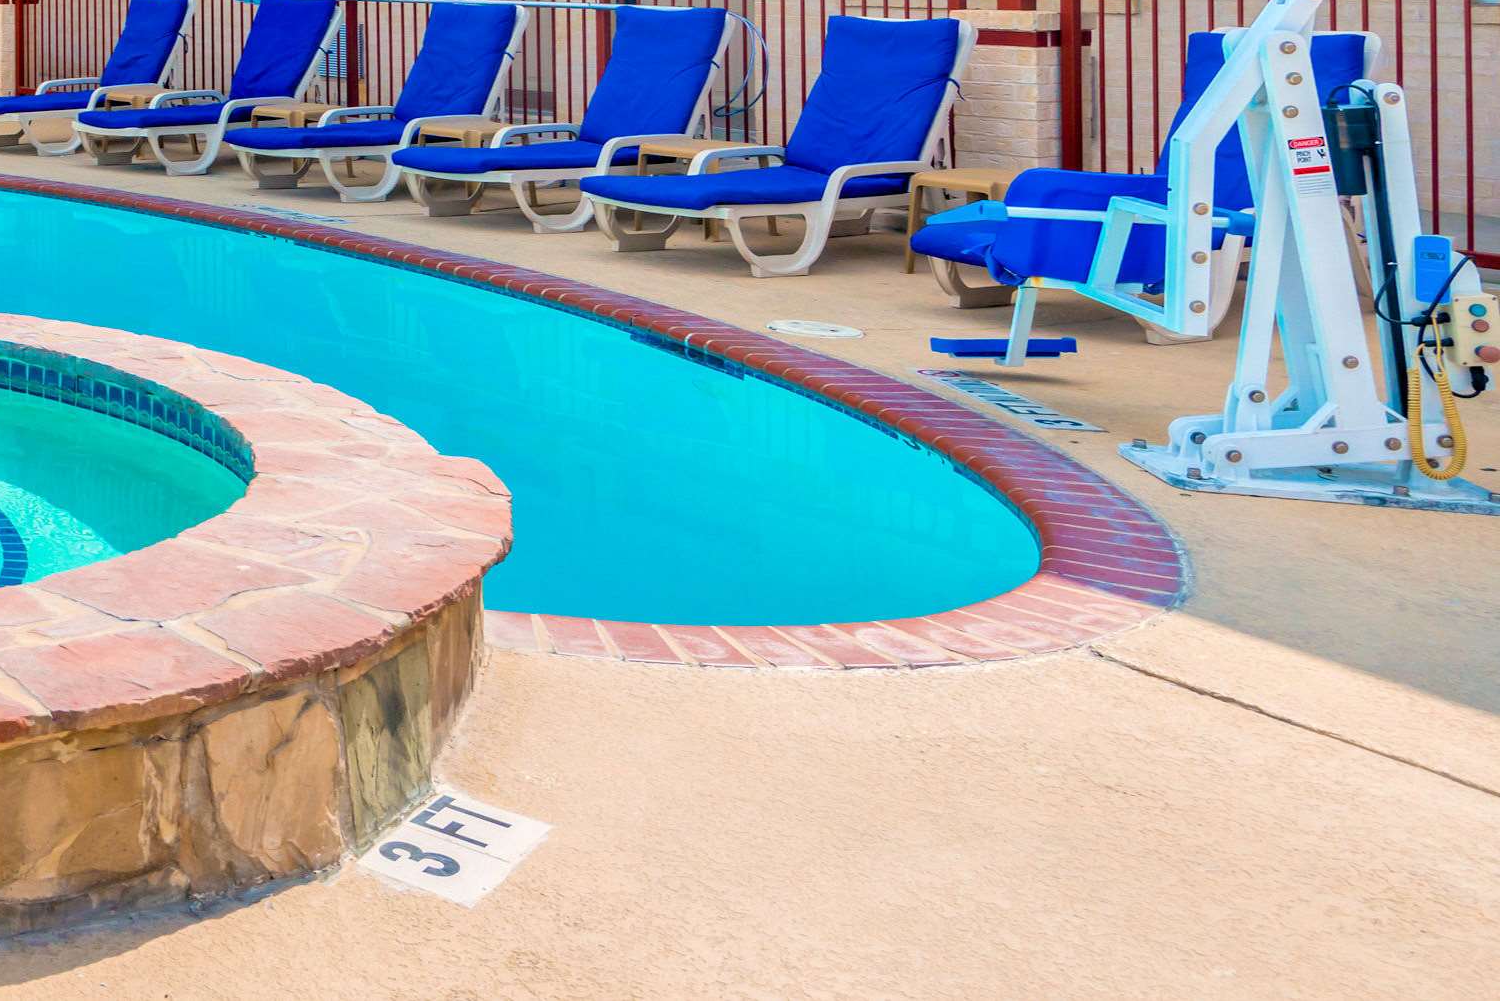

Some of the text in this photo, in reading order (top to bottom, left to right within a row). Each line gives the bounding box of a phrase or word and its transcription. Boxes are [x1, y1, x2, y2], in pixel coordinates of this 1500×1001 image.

[1292, 139, 1320, 147] DANGER
[995, 402, 1060, 415] FT
[378, 794, 513, 878] 3 FT
